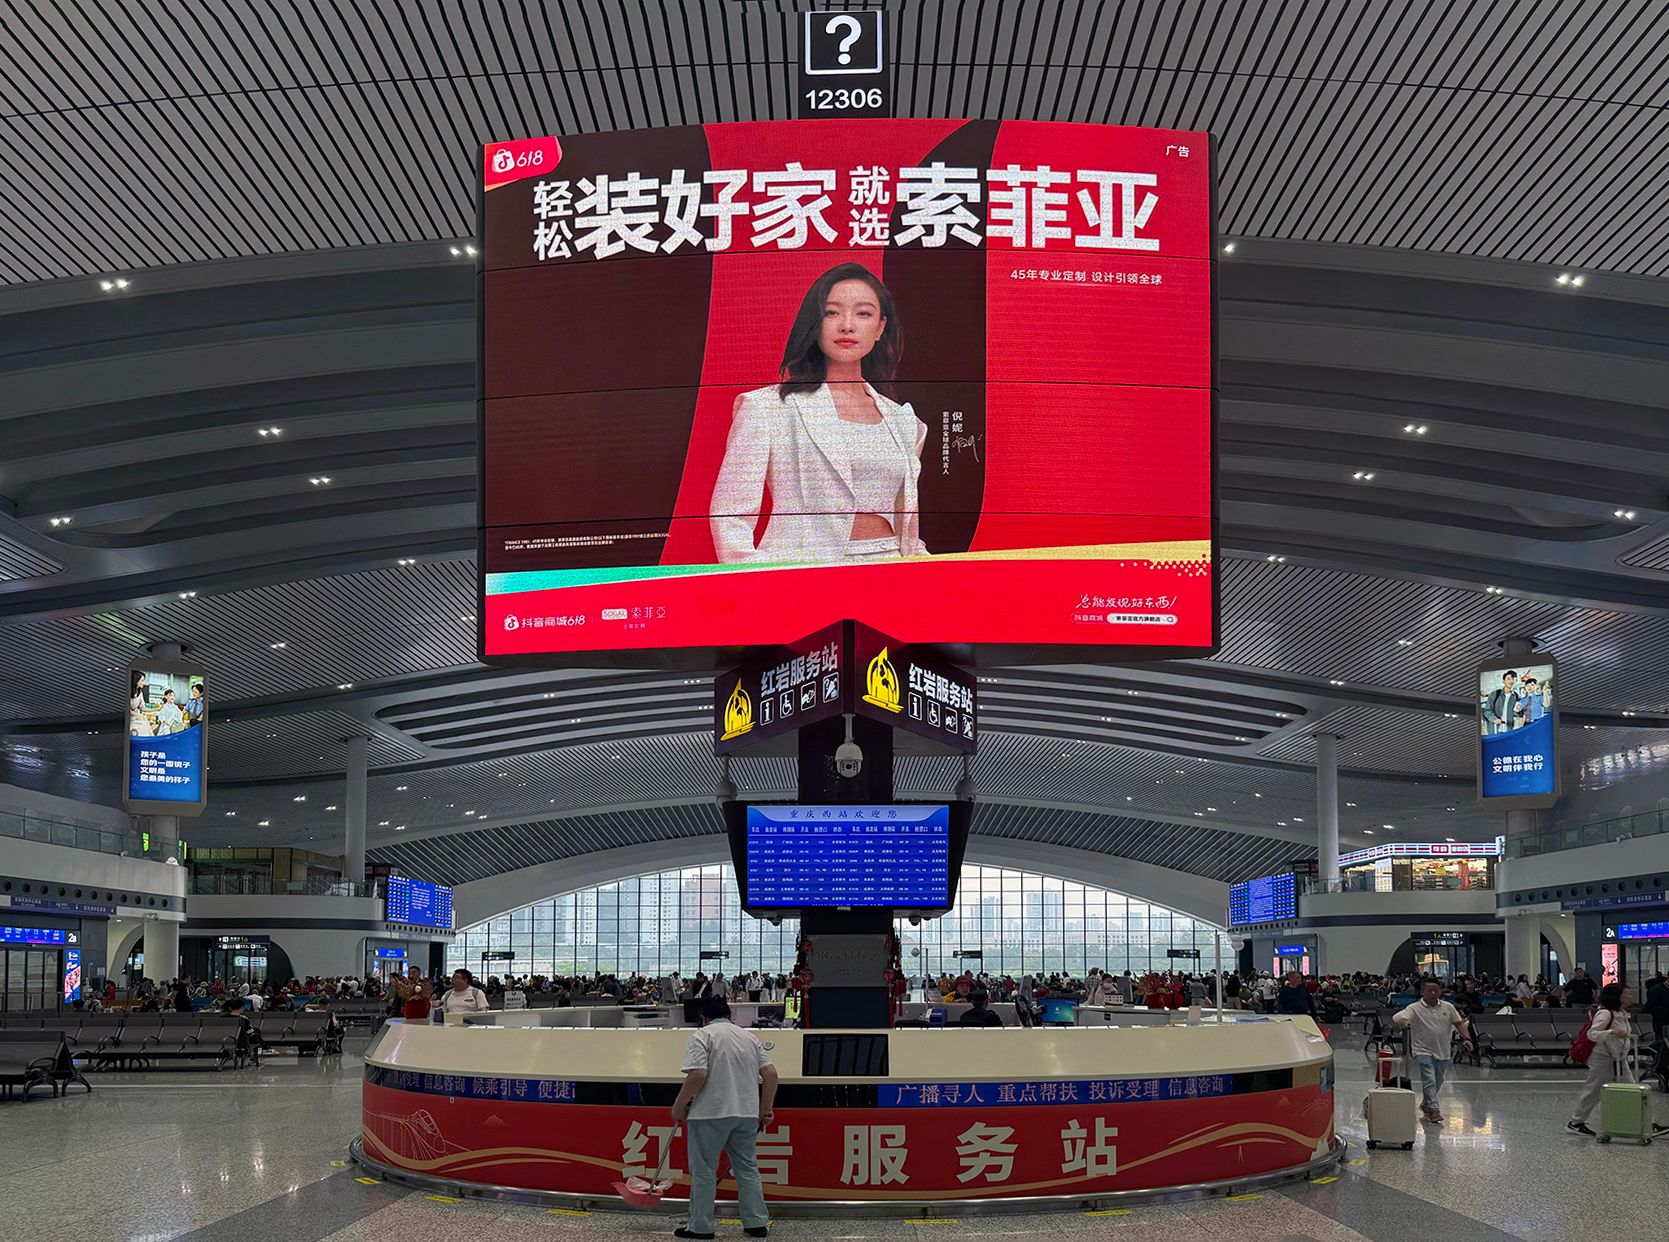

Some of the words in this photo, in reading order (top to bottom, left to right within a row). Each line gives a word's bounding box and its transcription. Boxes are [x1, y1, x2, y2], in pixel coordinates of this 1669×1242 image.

[806, 88, 882, 110] 12306
[516, 150, 543, 167] 618
[1165, 144, 1190, 158] 广告
[573, 161, 839, 261] 装好家
[894, 161, 1160, 252] 索菲亚
[1010, 269, 1087, 283] 45年专业定制
[1091, 271, 1163, 286] 设计引领全球
[952, 411, 963, 432] 倪妮
[521, 614, 586, 628] 抖音商城618
[760, 641, 839, 697] 红岩服务站
[908, 662, 973, 714] 红岩服务站
[140, 751, 166, 759] 孩子是
[1492, 754, 1544, 765] 公德在我心
[140, 767, 166, 775] 文明是
[1492, 763, 1544, 774] 文明伴我行
[789, 808, 897, 819] 重庆西站欢迎您
[1606, 928, 1615, 938] 2A
[538, 1080, 576, 1099] 便捷
[896, 1084, 984, 1104] 广播寻人
[997, 1082, 1078, 1103] 重点帮扶
[1089, 1080, 1159, 1100] 投诉受理
[1167, 1075, 1224, 1096] 信息咨询
